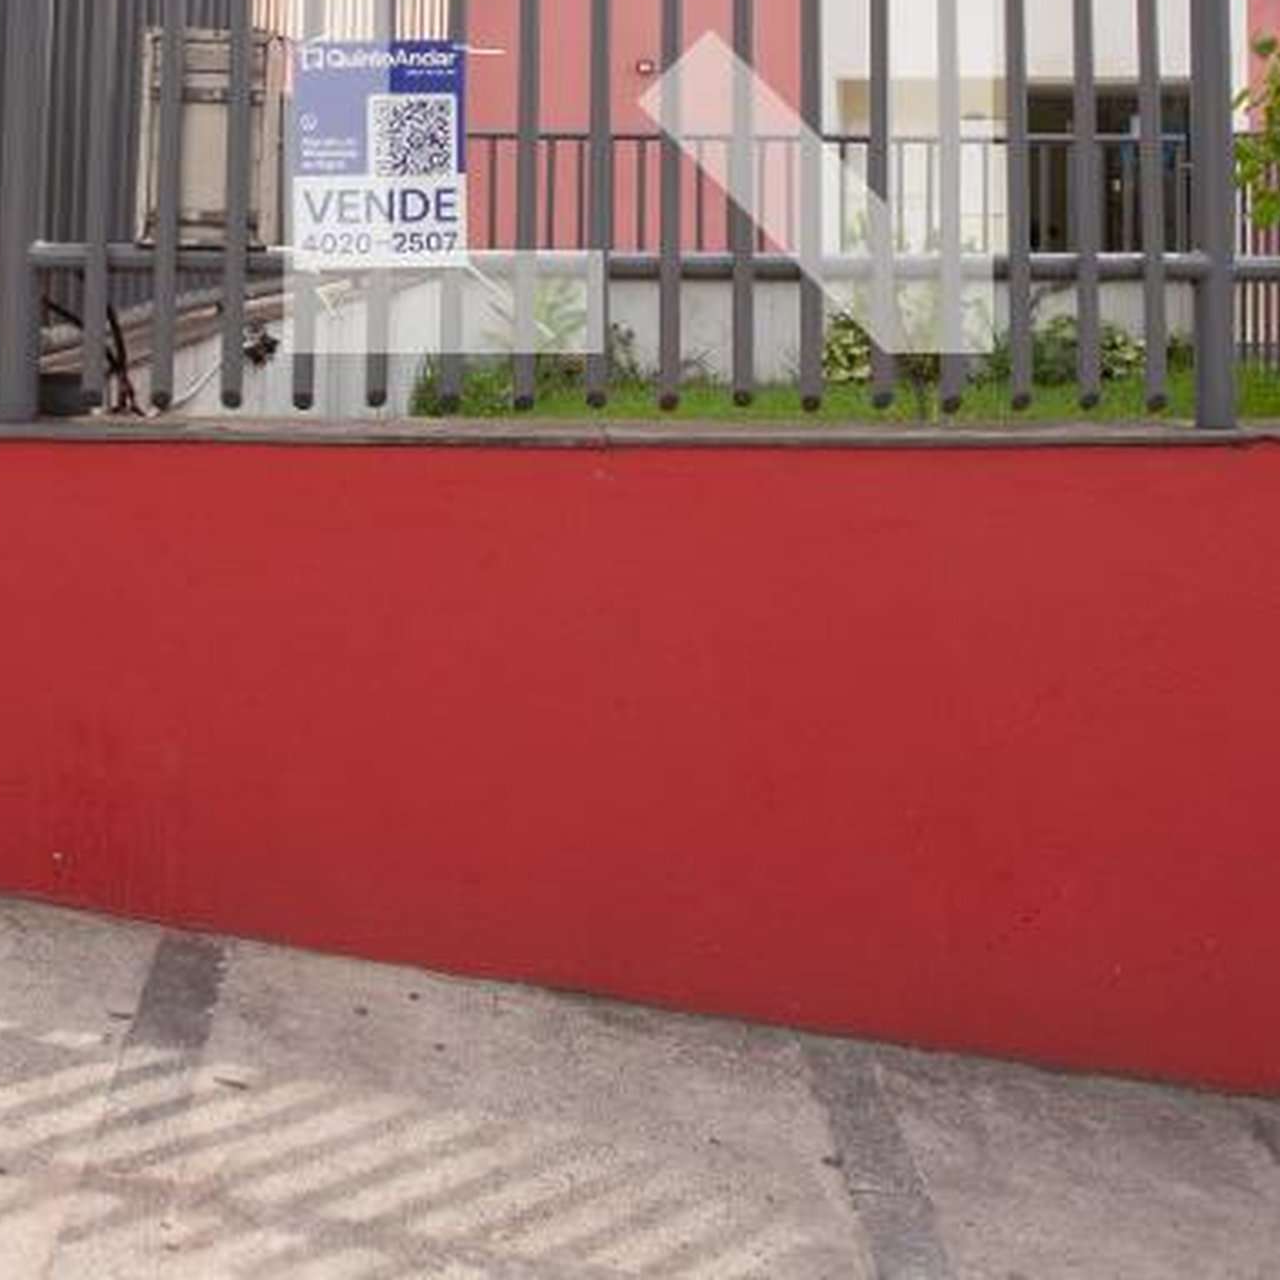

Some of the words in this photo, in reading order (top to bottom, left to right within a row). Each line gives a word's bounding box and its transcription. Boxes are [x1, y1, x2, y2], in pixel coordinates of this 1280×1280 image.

[326, 48, 459, 67] QuintoAndar
[302, 187, 458, 224] VENDE
[301, 231, 458, 255] 4020-2507
